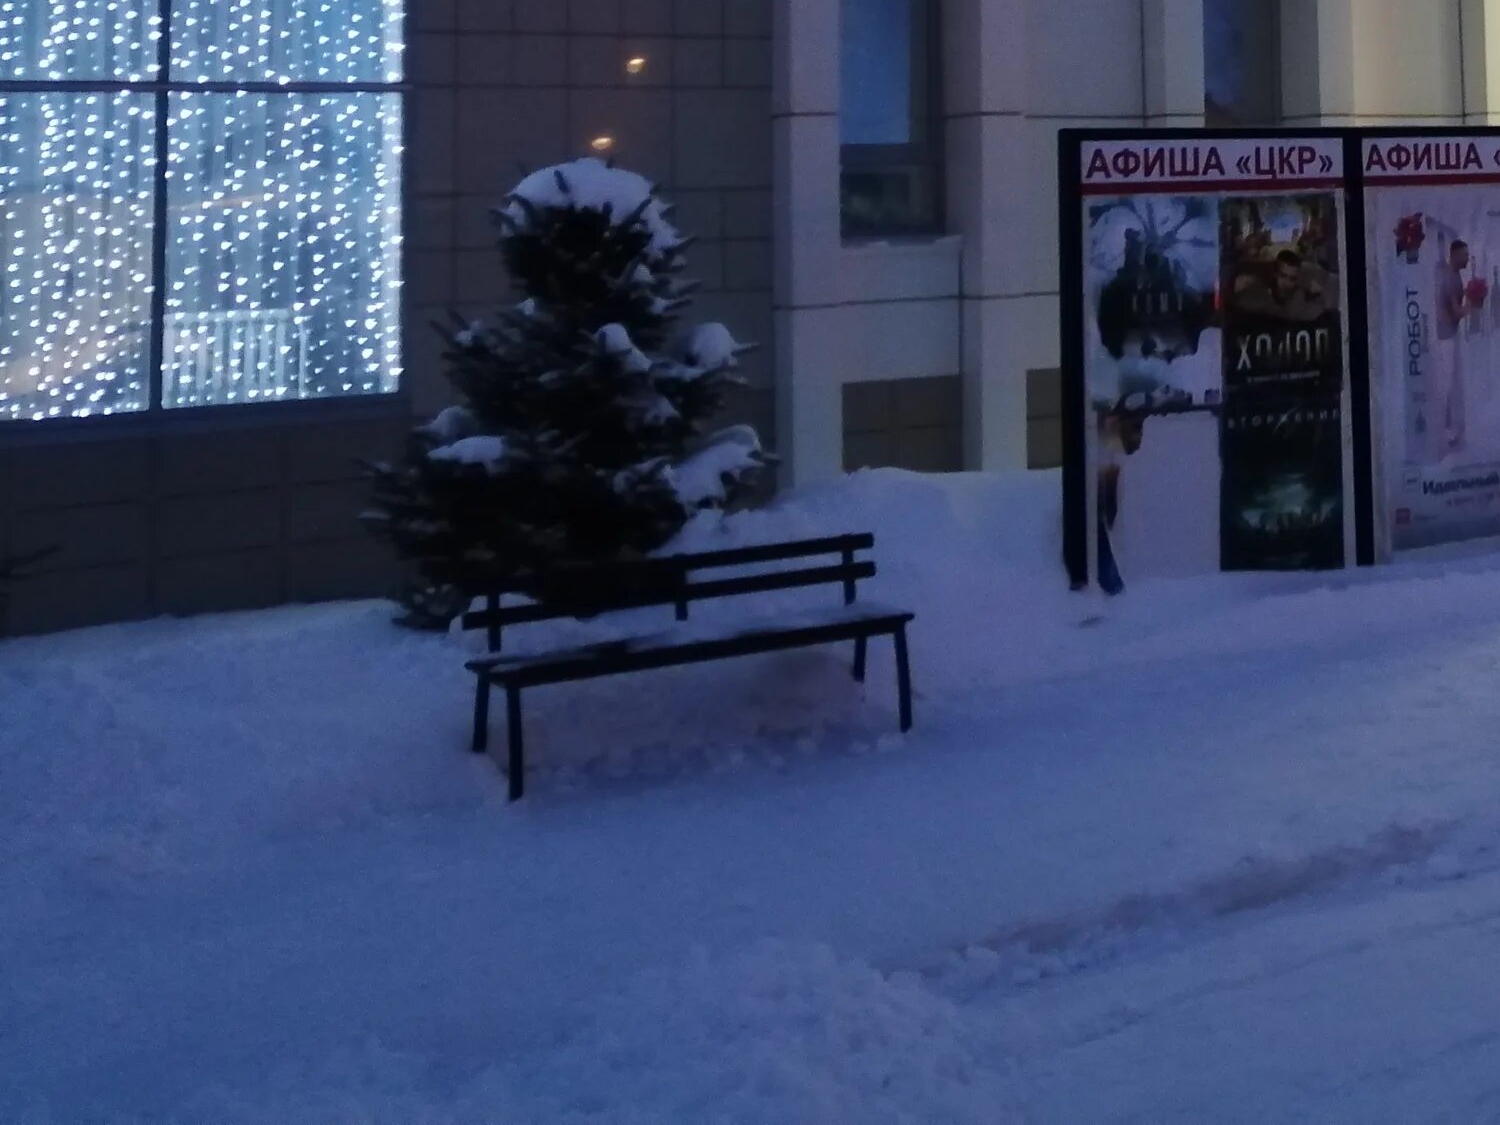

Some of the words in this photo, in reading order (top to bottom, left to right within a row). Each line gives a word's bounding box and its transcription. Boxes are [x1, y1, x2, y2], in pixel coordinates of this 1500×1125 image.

[1086, 145, 1225, 179] АФИША
[1236, 144, 1334, 179] «ЦКР»
[1365, 142, 1484, 172] АФИША
[1406, 286, 1422, 376] РОБОТ
